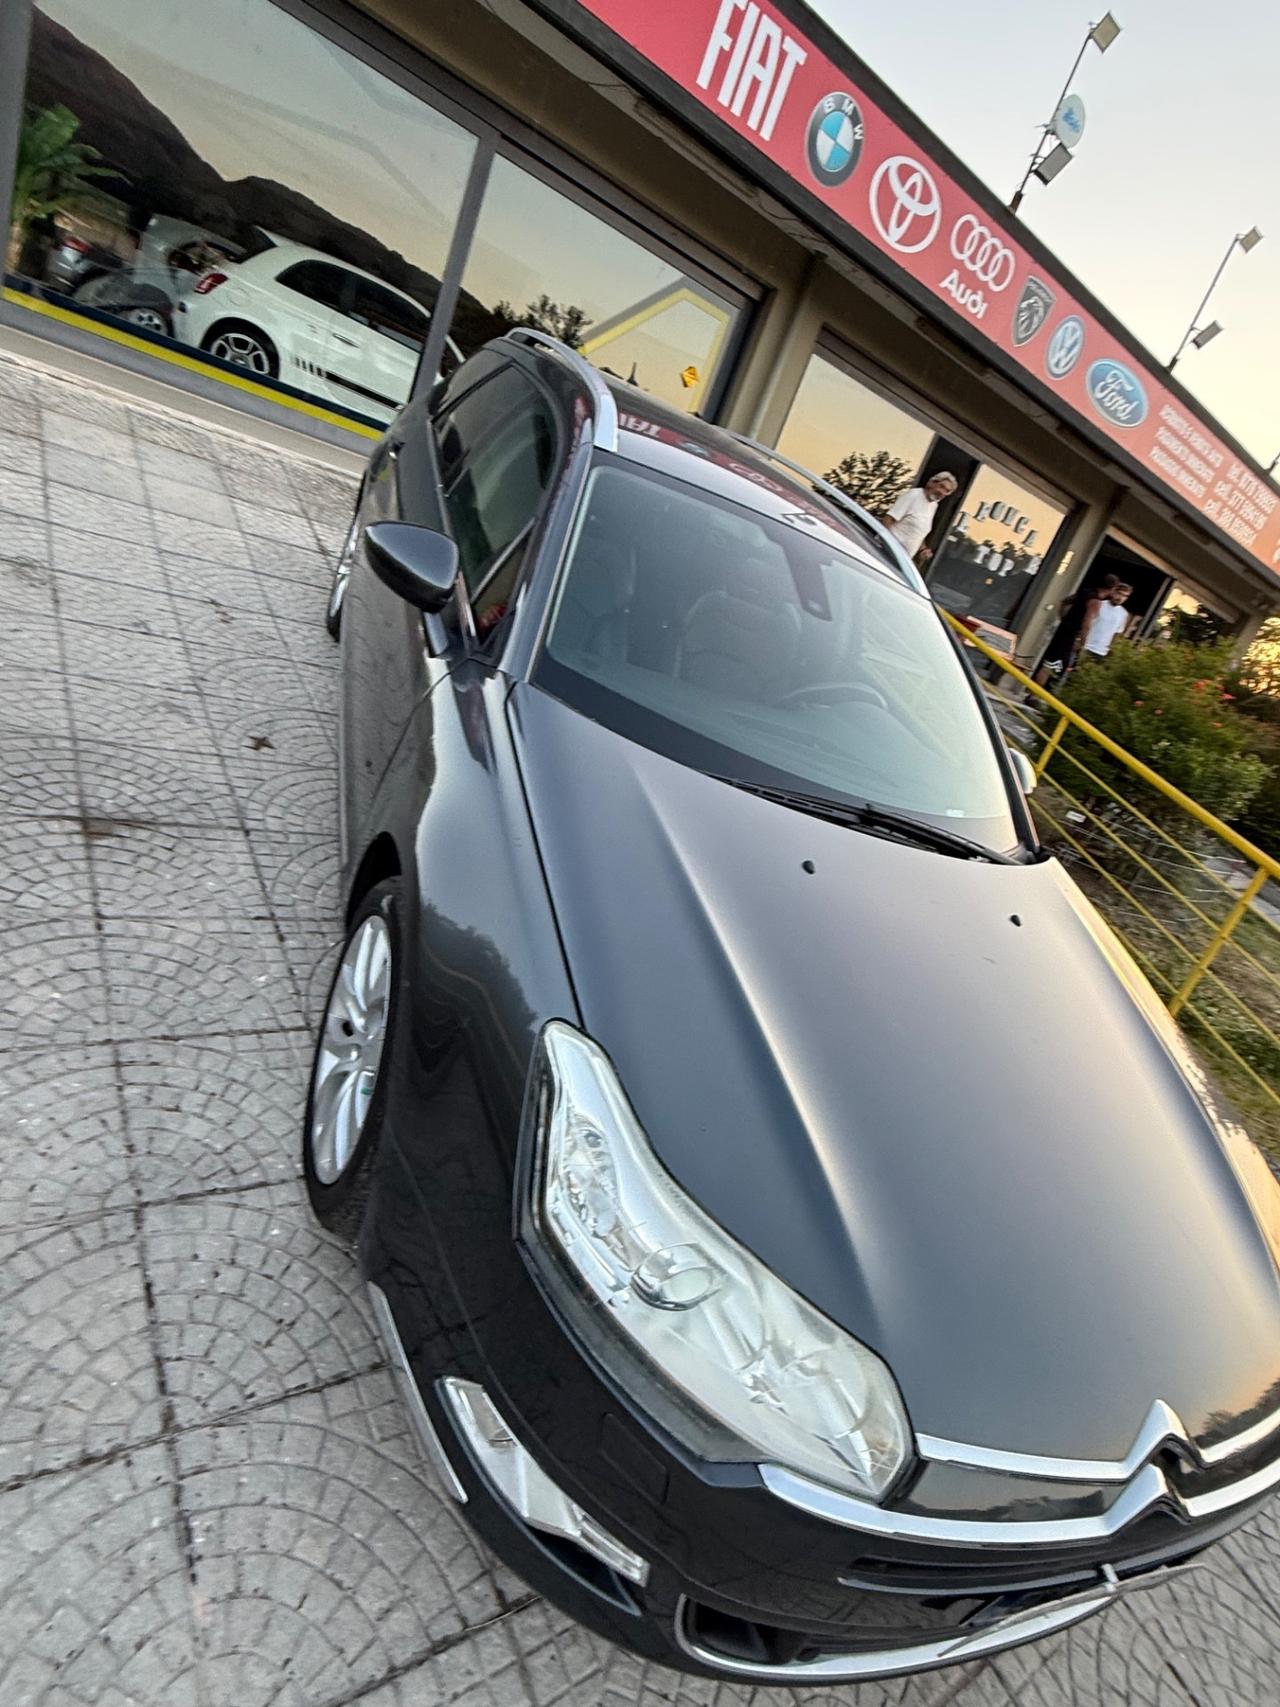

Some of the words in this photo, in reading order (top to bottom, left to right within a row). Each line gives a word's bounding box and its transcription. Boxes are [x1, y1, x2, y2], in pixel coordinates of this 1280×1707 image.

[696, 0, 808, 142] FIAT
[939, 269, 988, 319] Audi
[1095, 370, 1140, 420] Ford
